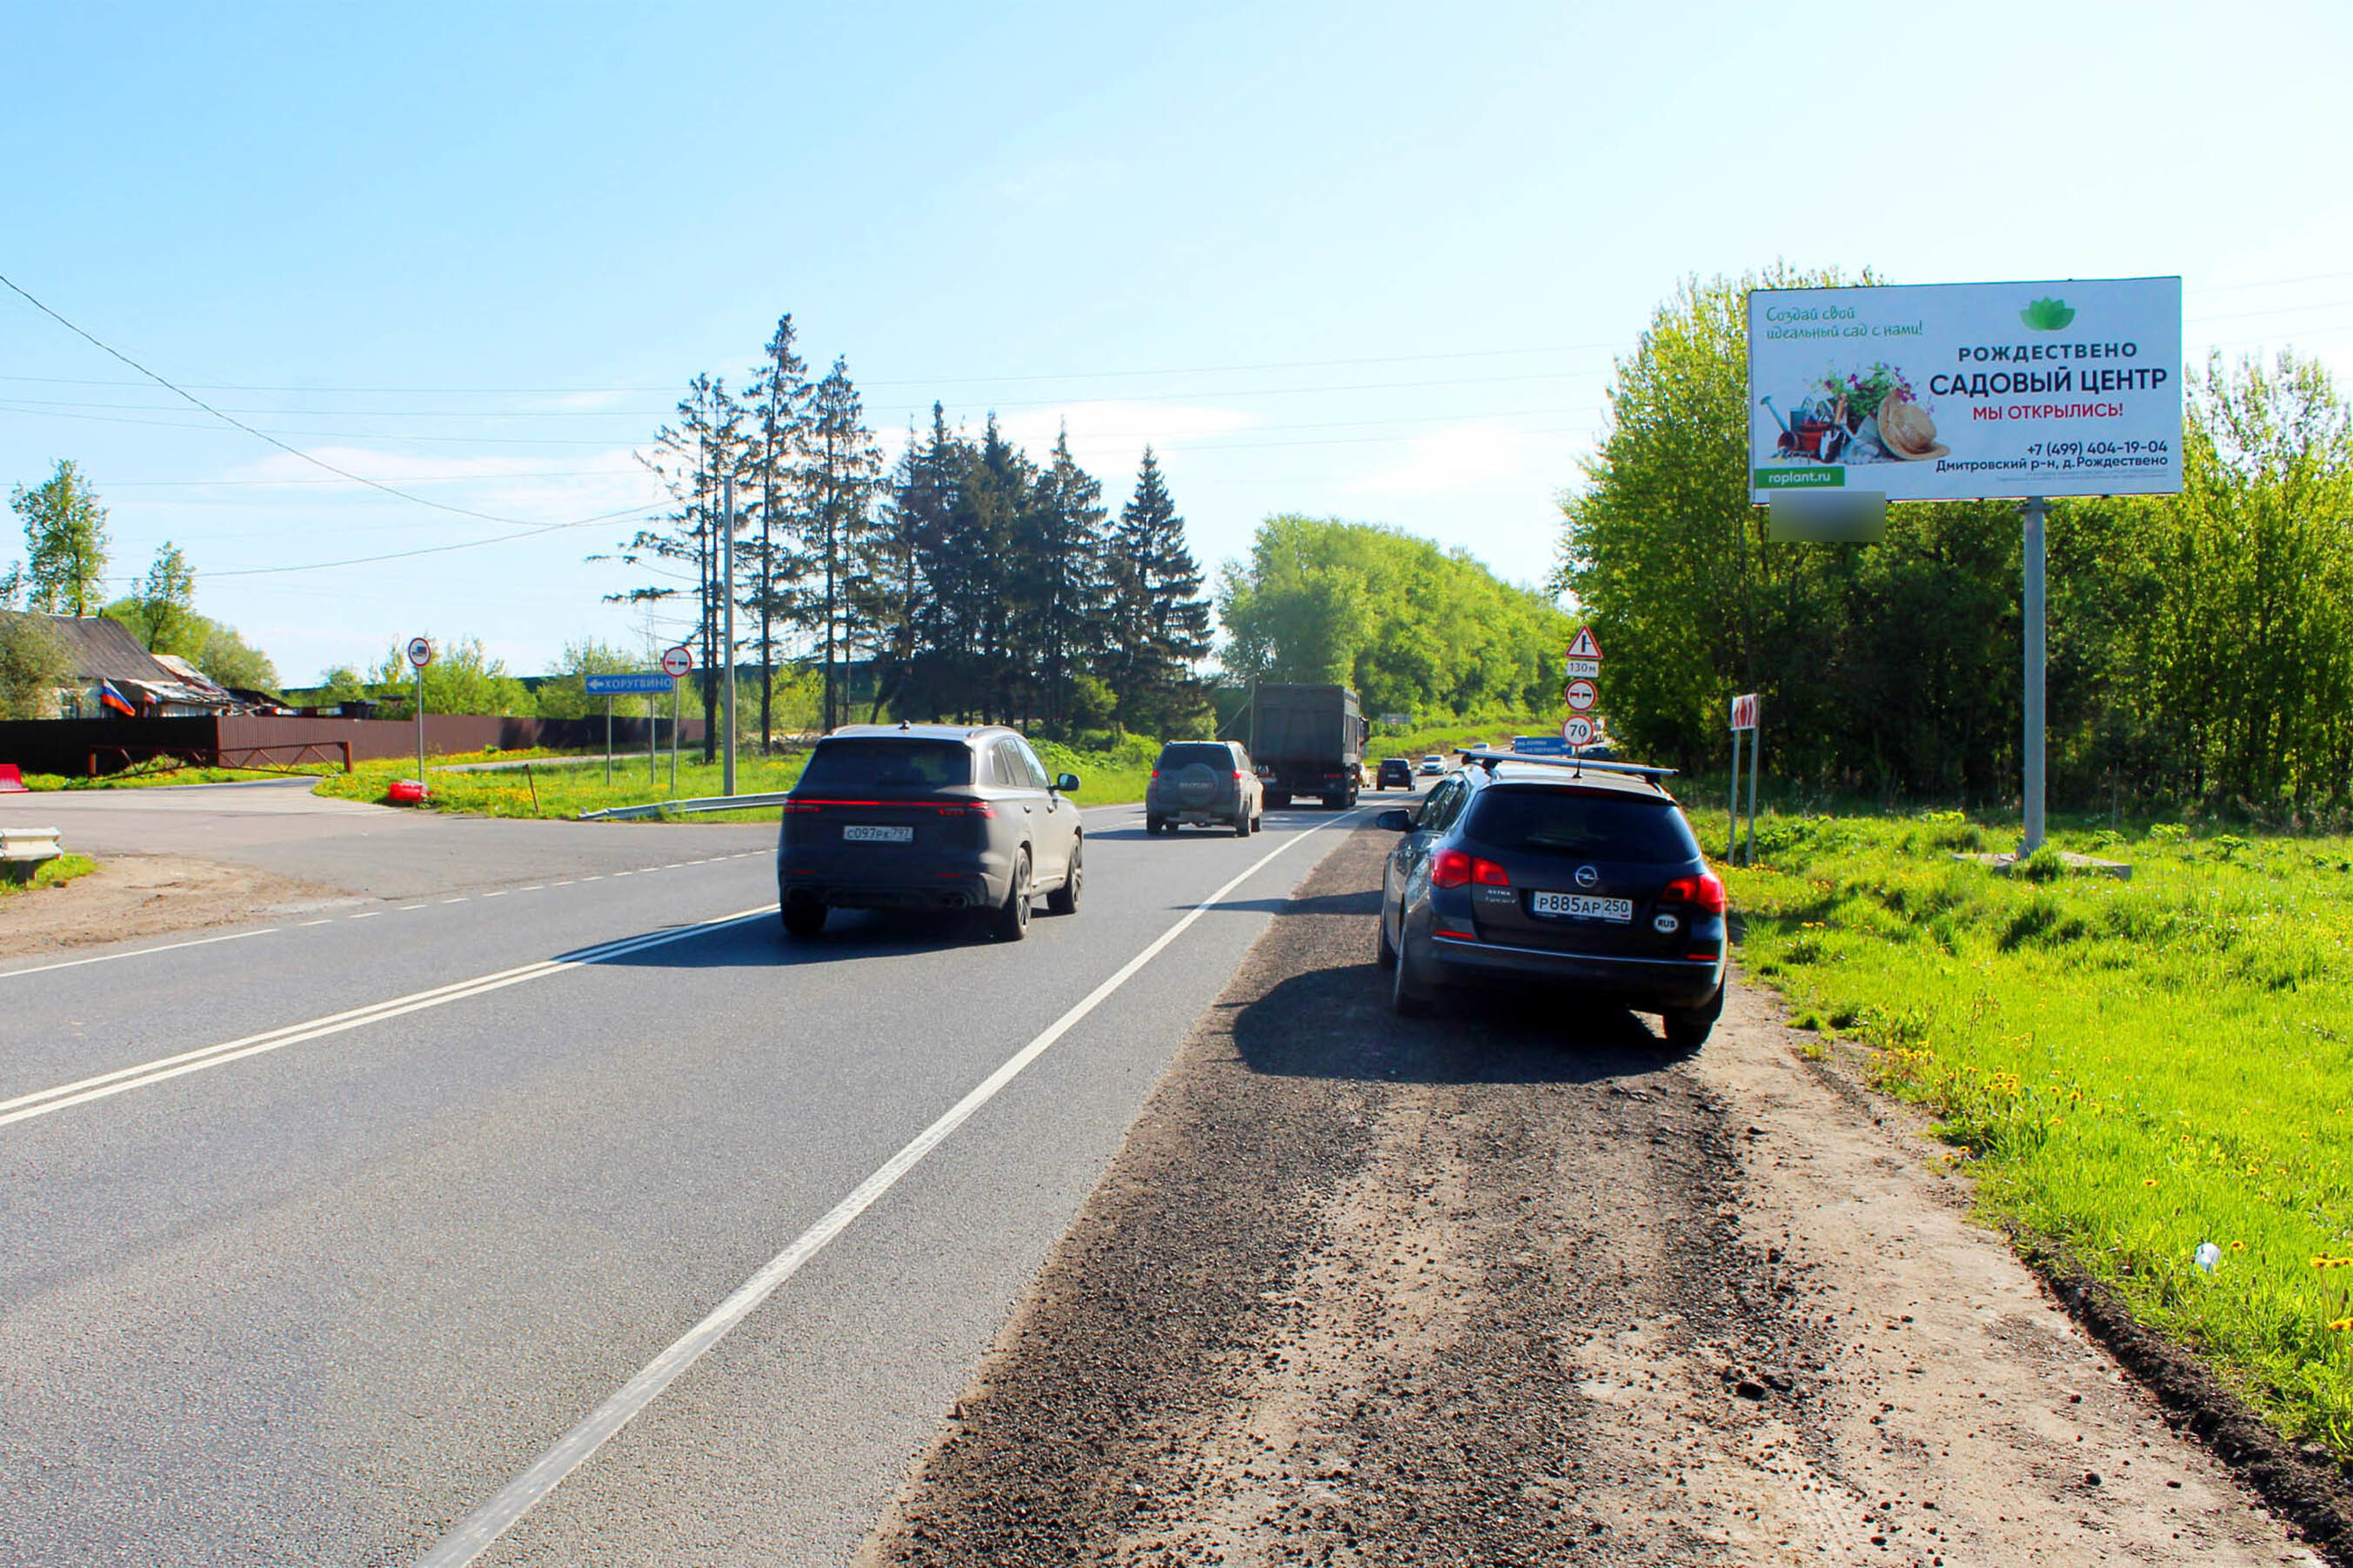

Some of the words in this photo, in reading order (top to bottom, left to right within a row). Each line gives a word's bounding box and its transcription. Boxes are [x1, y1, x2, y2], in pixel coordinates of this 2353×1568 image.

[1766, 306, 1818, 324] Создай
[1822, 305, 1855, 320] свой
[1767, 325, 1839, 340] идеальный
[1842, 322, 1868, 337] сад
[1871, 326, 1881, 337] с
[1883, 320, 1922, 337] нами!
[1958, 342, 2137, 363] РОЖДЕСТВЕНО
[1929, 366, 2071, 398] САДОВЫЙ
[2081, 368, 2168, 395] ЦЕНТР
[1973, 405, 2002, 421] МЫ
[2008, 403, 2123, 420] ОТКРЫЛИСЬ!
[2027, 444, 2042, 456] +7
[2047, 442, 2082, 457] (499)
[2087, 440, 2168, 455] 404-19-04
[1935, 457, 2027, 473] Дмитровский
[2030, 459, 2059, 471] р-н,
[1768, 470, 1831, 486] roplant.ru
[605, 678, 672, 690] ХОРУГВИНО
[1569, 724, 1588, 737] 70
